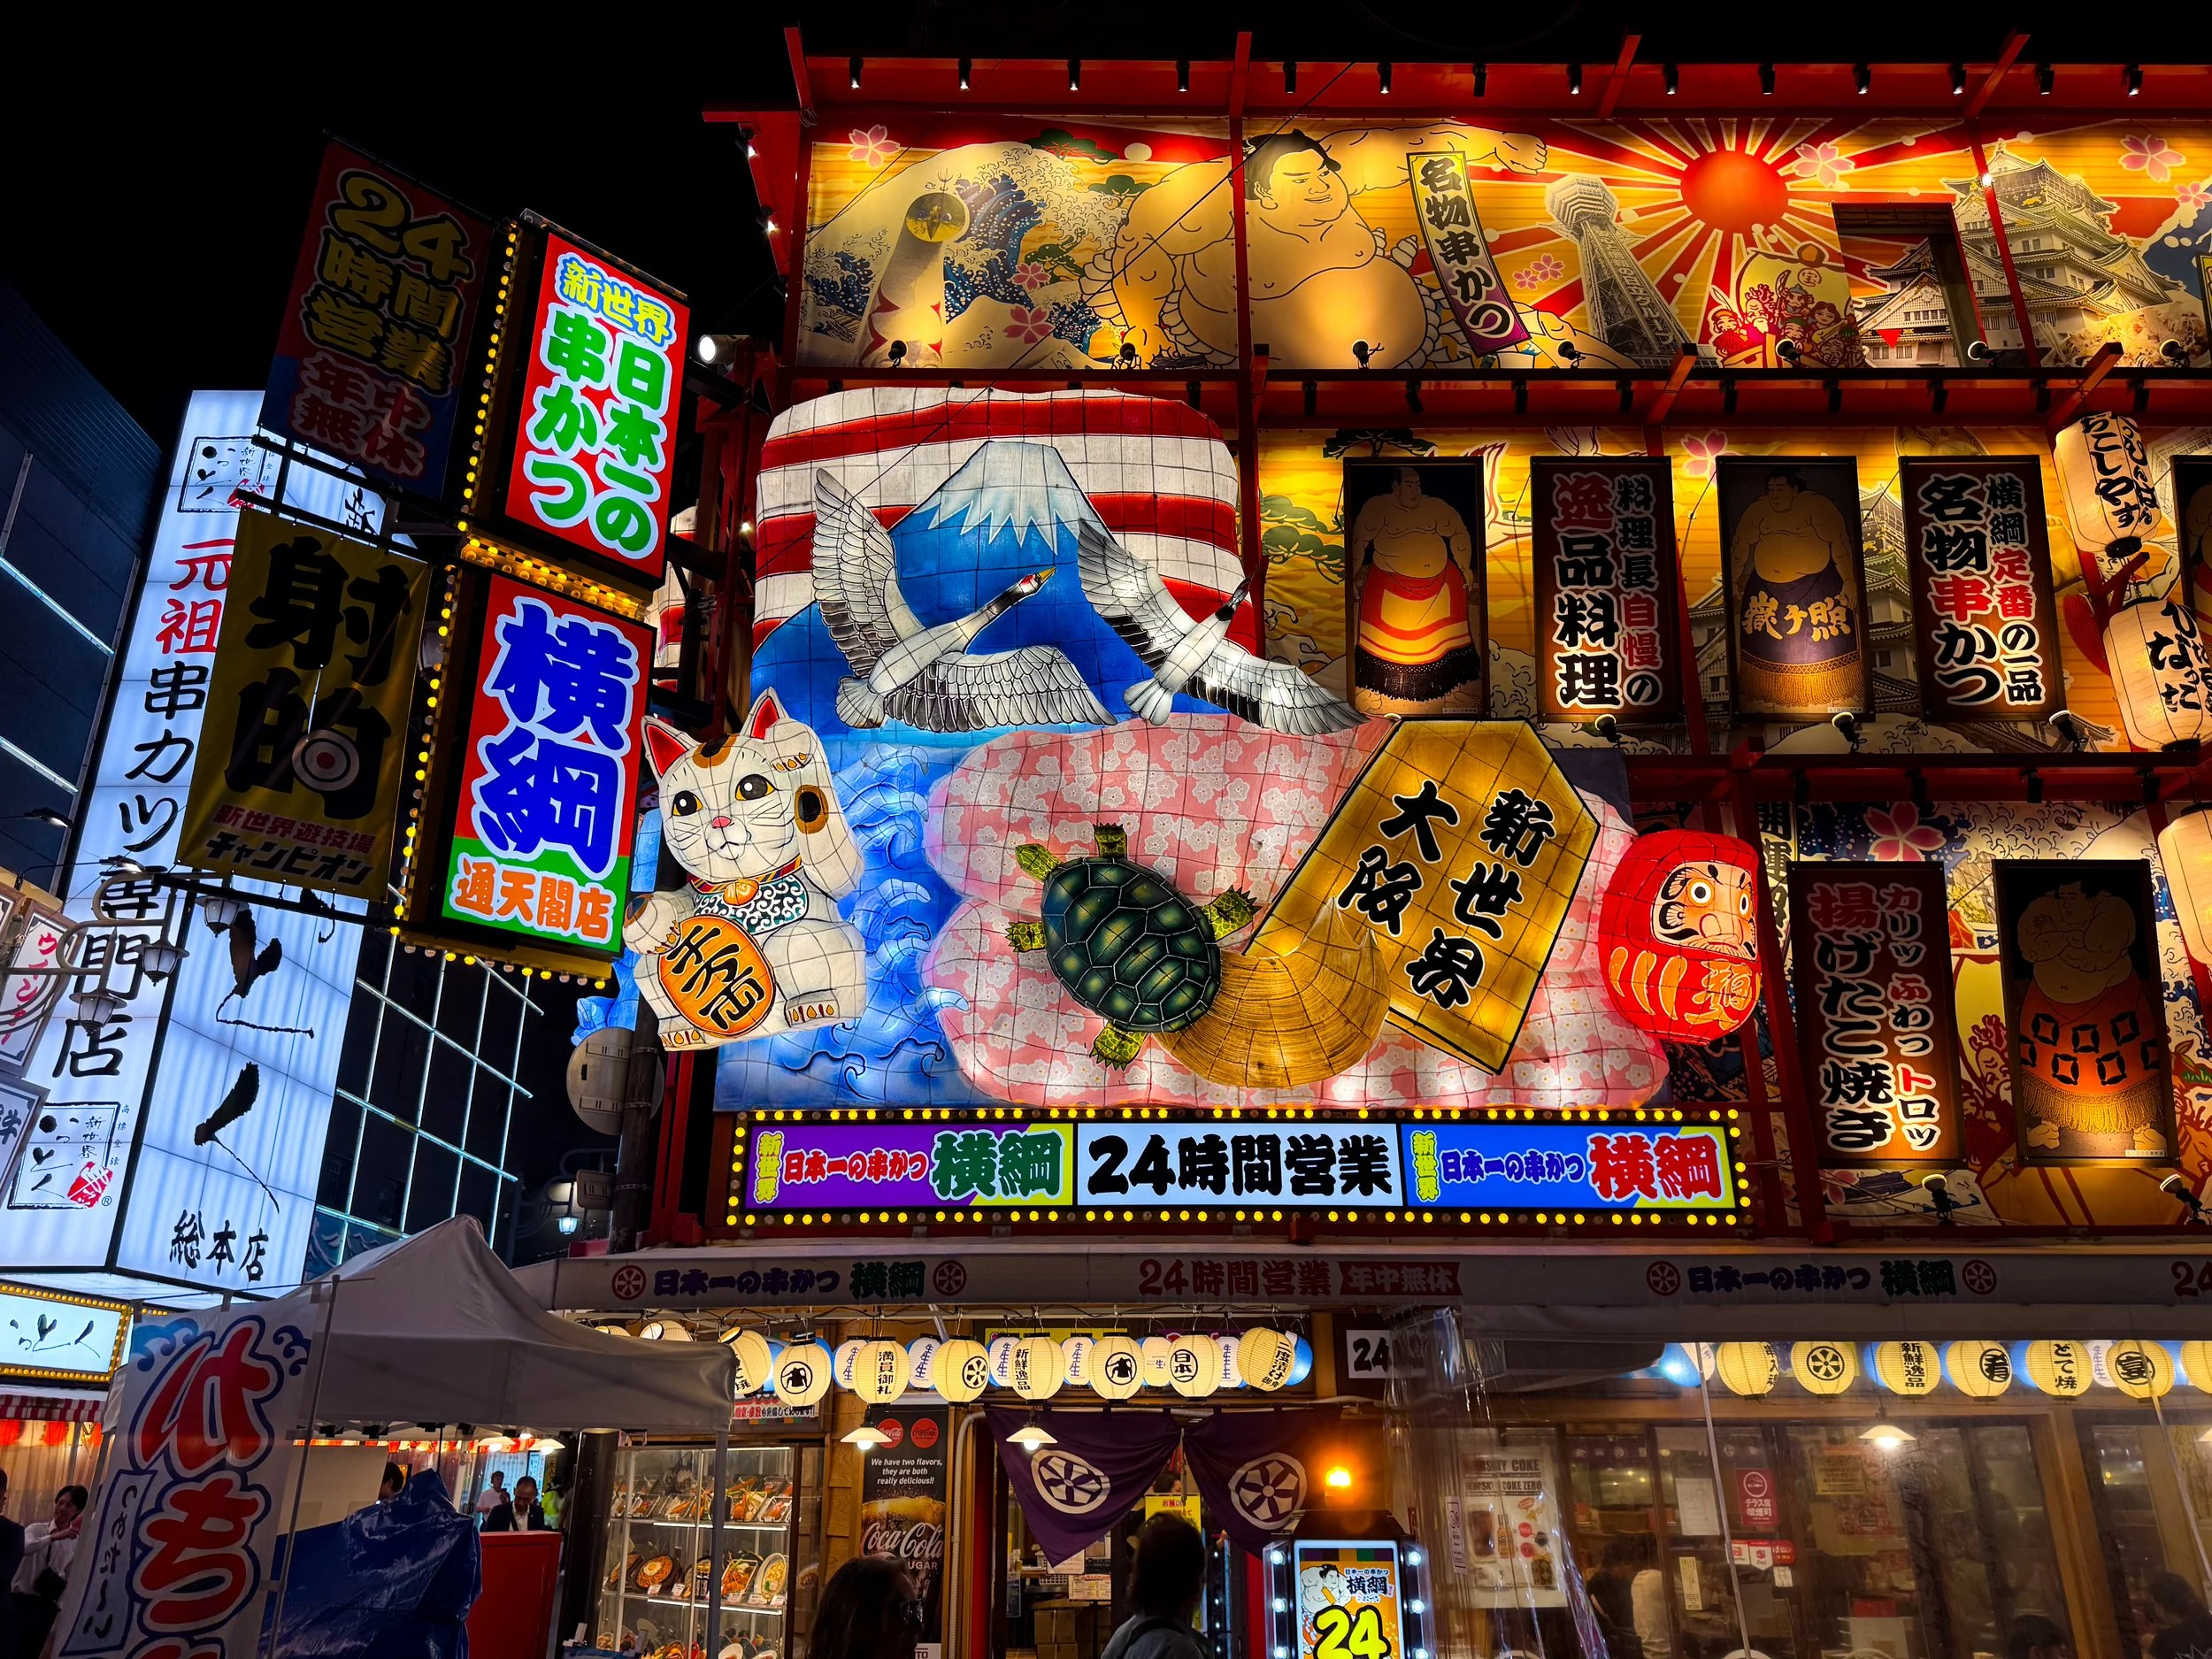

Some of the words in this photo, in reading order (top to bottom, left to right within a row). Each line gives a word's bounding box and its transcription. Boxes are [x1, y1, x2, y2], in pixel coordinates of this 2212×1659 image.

[332, 173, 469, 280] 24
[1419, 155, 1515, 340] 名物串かつ
[320, 236, 462, 340] 時間
[559, 257, 674, 345] 新世界
[303, 285, 453, 397] 営業
[299, 354, 431, 431] 年中
[534, 310, 606, 523] 串かつ
[290, 396, 426, 479] 無休
[597, 337, 666, 556] 日本一の
[1552, 472, 1624, 709] 逸品料理
[1616, 475, 1663, 704] 料理長自慢の
[1918, 474, 2001, 705] 名物串かつ
[1985, 475, 2044, 705] 横綱定番の一品
[476, 603, 636, 876] 横綱
[204, 831, 373, 886] チャンピオン
[1338, 780, 1460, 935] 大阪
[453, 855, 614, 941] 通天閣店
[1406, 787, 1557, 1010] 新世界
[1880, 885, 1922, 967] カリッ
[1807, 884, 1894, 1150] 揚げたこ焼き
[1888, 975, 1932, 1053] ふわっ
[1896, 1066, 1939, 1149] トロッ
[757, 1132, 783, 1203] 新世界
[783, 1149, 927, 1183] 日本一の串かつ
[932, 1131, 1063, 1200] 横綱
[1087, 1134, 1393, 1196] 24時間営業
[1412, 1132, 1440, 1202] 新世界
[1441, 1149, 1585, 1183] 日本一の串かつ
[1589, 1132, 1722, 1201] 横綱
[170, 1208, 270, 1283] 総本店
[653, 1269, 841, 1295] 日本一の串かつ
[849, 1260, 926, 1298] 横綱
[1139, 1259, 1333, 1297] 24時間営業
[1344, 1262, 1455, 1294] 年中無休
[1686, 1265, 1870, 1292] 日本一の串かつ
[1879, 1259, 1956, 1296] 横綱
[1014, 1348, 1032, 1391] 新鮮逸品
[1900, 1342, 1926, 1388] 新鮮逸品
[2054, 1342, 2078, 1389] どて焼
[877, 1477, 897, 1486] really
[917, 1458, 942, 1467] flavors,
[1502, 1480, 1522, 1491] COKE
[1523, 1480, 1543, 1491] ZERO
[1511, 1459, 1540, 1471] COKE
[908, 1561, 938, 1571] UGAR
[1346, 1575, 1388, 1594] 横綱
[1315, 1608, 1389, 1659] 24
